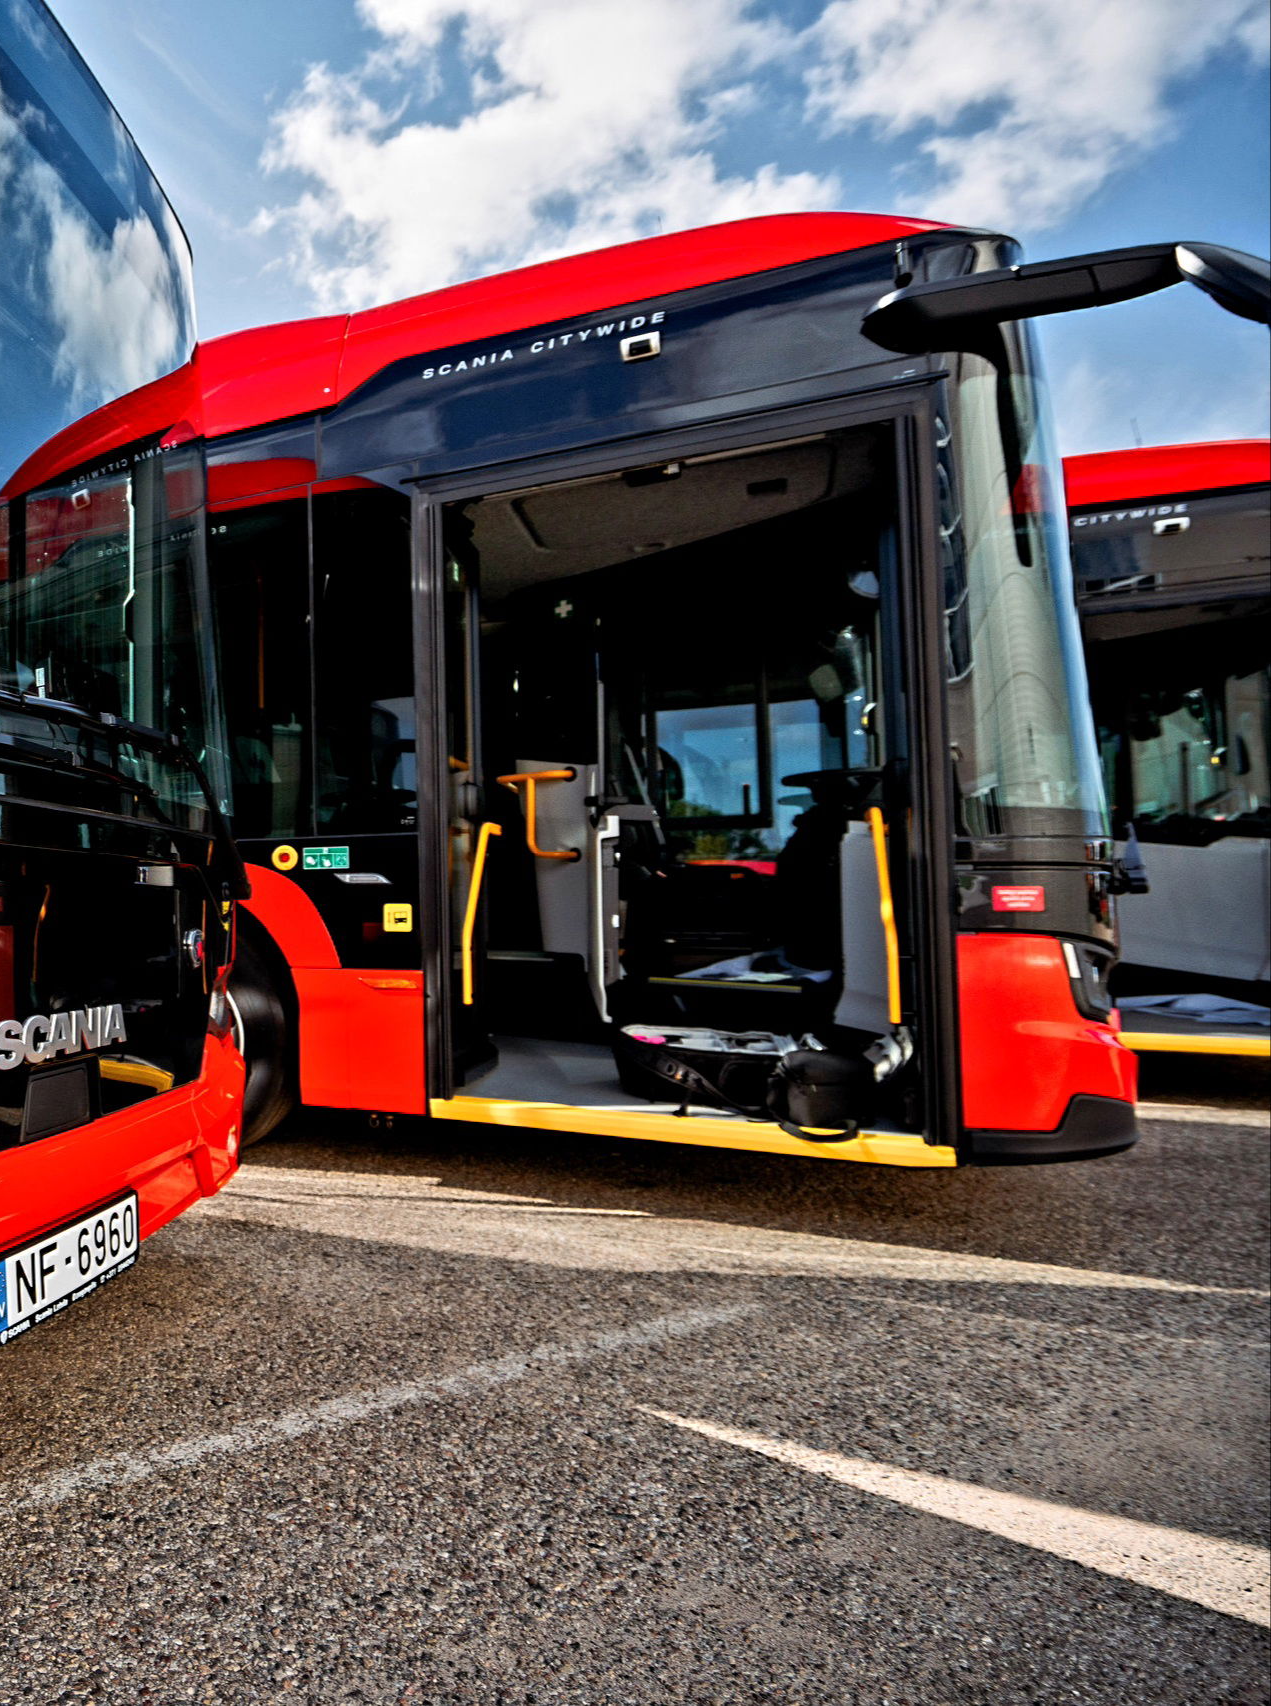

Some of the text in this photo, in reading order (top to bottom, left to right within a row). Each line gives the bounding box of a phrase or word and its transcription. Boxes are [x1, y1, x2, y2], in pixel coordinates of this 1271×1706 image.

[422, 311, 666, 380] SCANIA CITYWIDE
[1074, 503, 1188, 527] CITYWIDE
